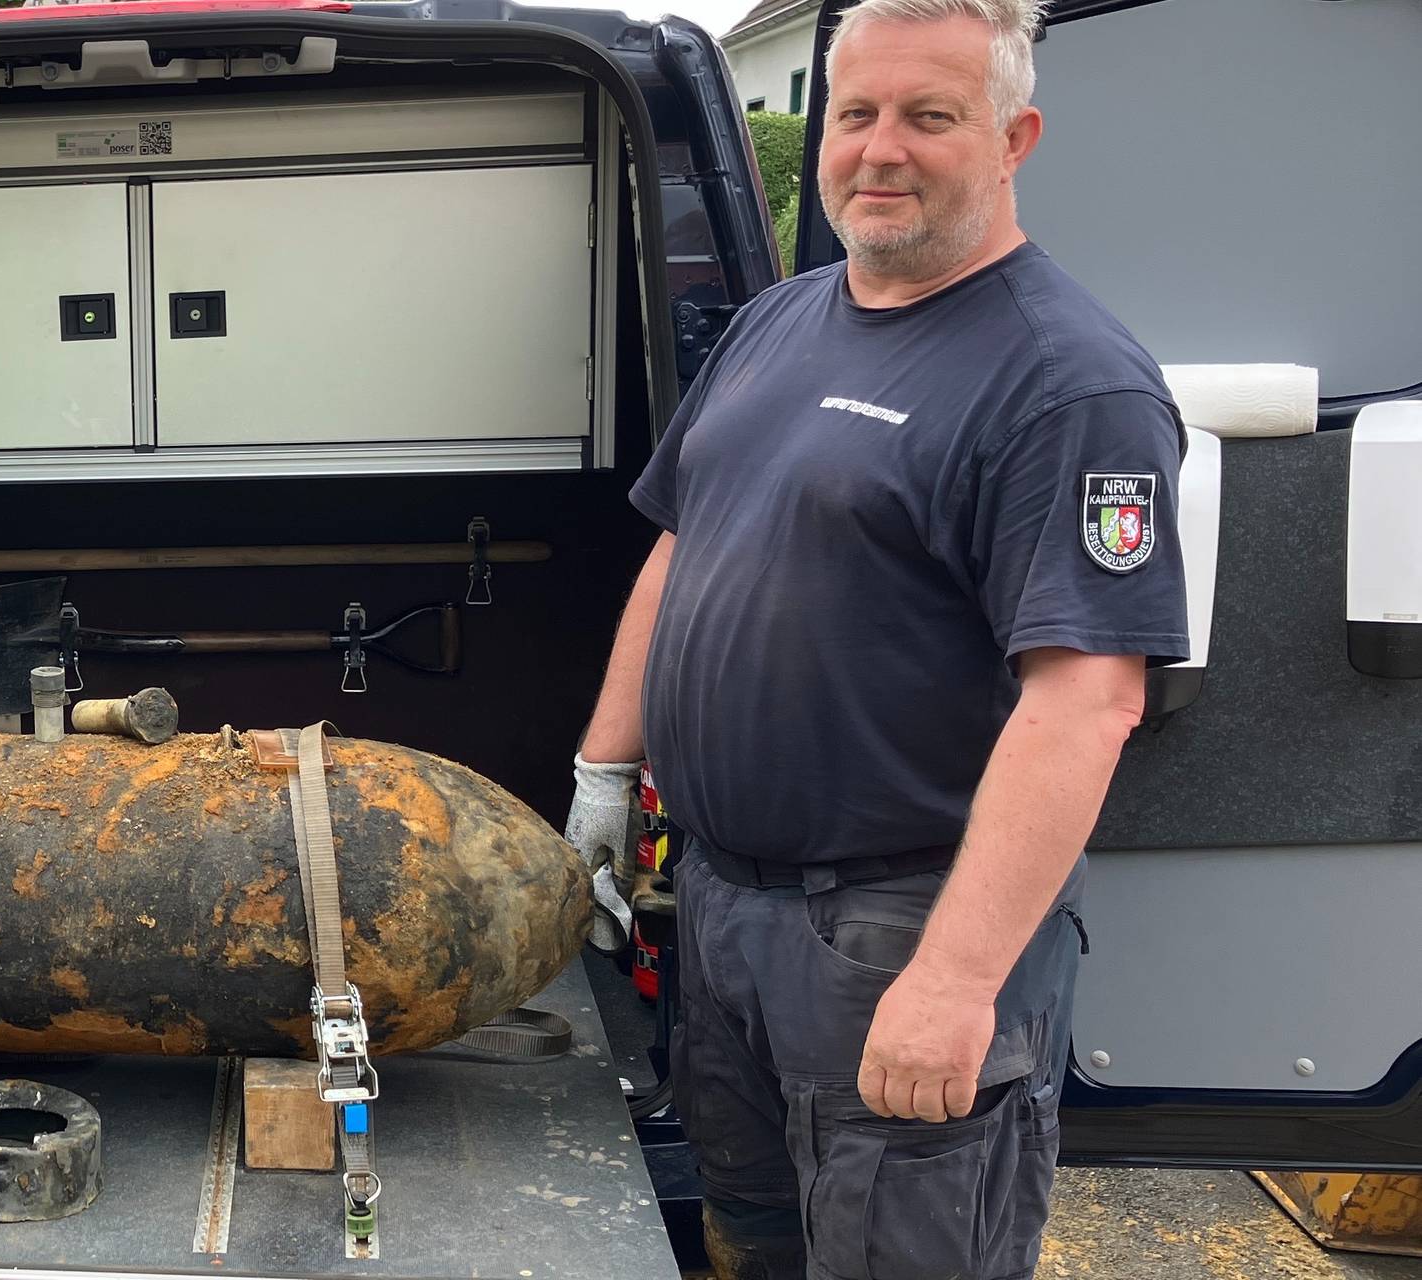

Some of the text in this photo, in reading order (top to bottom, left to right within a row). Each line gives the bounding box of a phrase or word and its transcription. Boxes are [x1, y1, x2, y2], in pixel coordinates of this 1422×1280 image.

[109, 144, 135, 155] poser
[1103, 479, 1139, 495] NRW
[1089, 494, 1150, 506] KAMPFMITTEL-
[1087, 522, 1151, 567] BESEITIGUNGSDIENST
